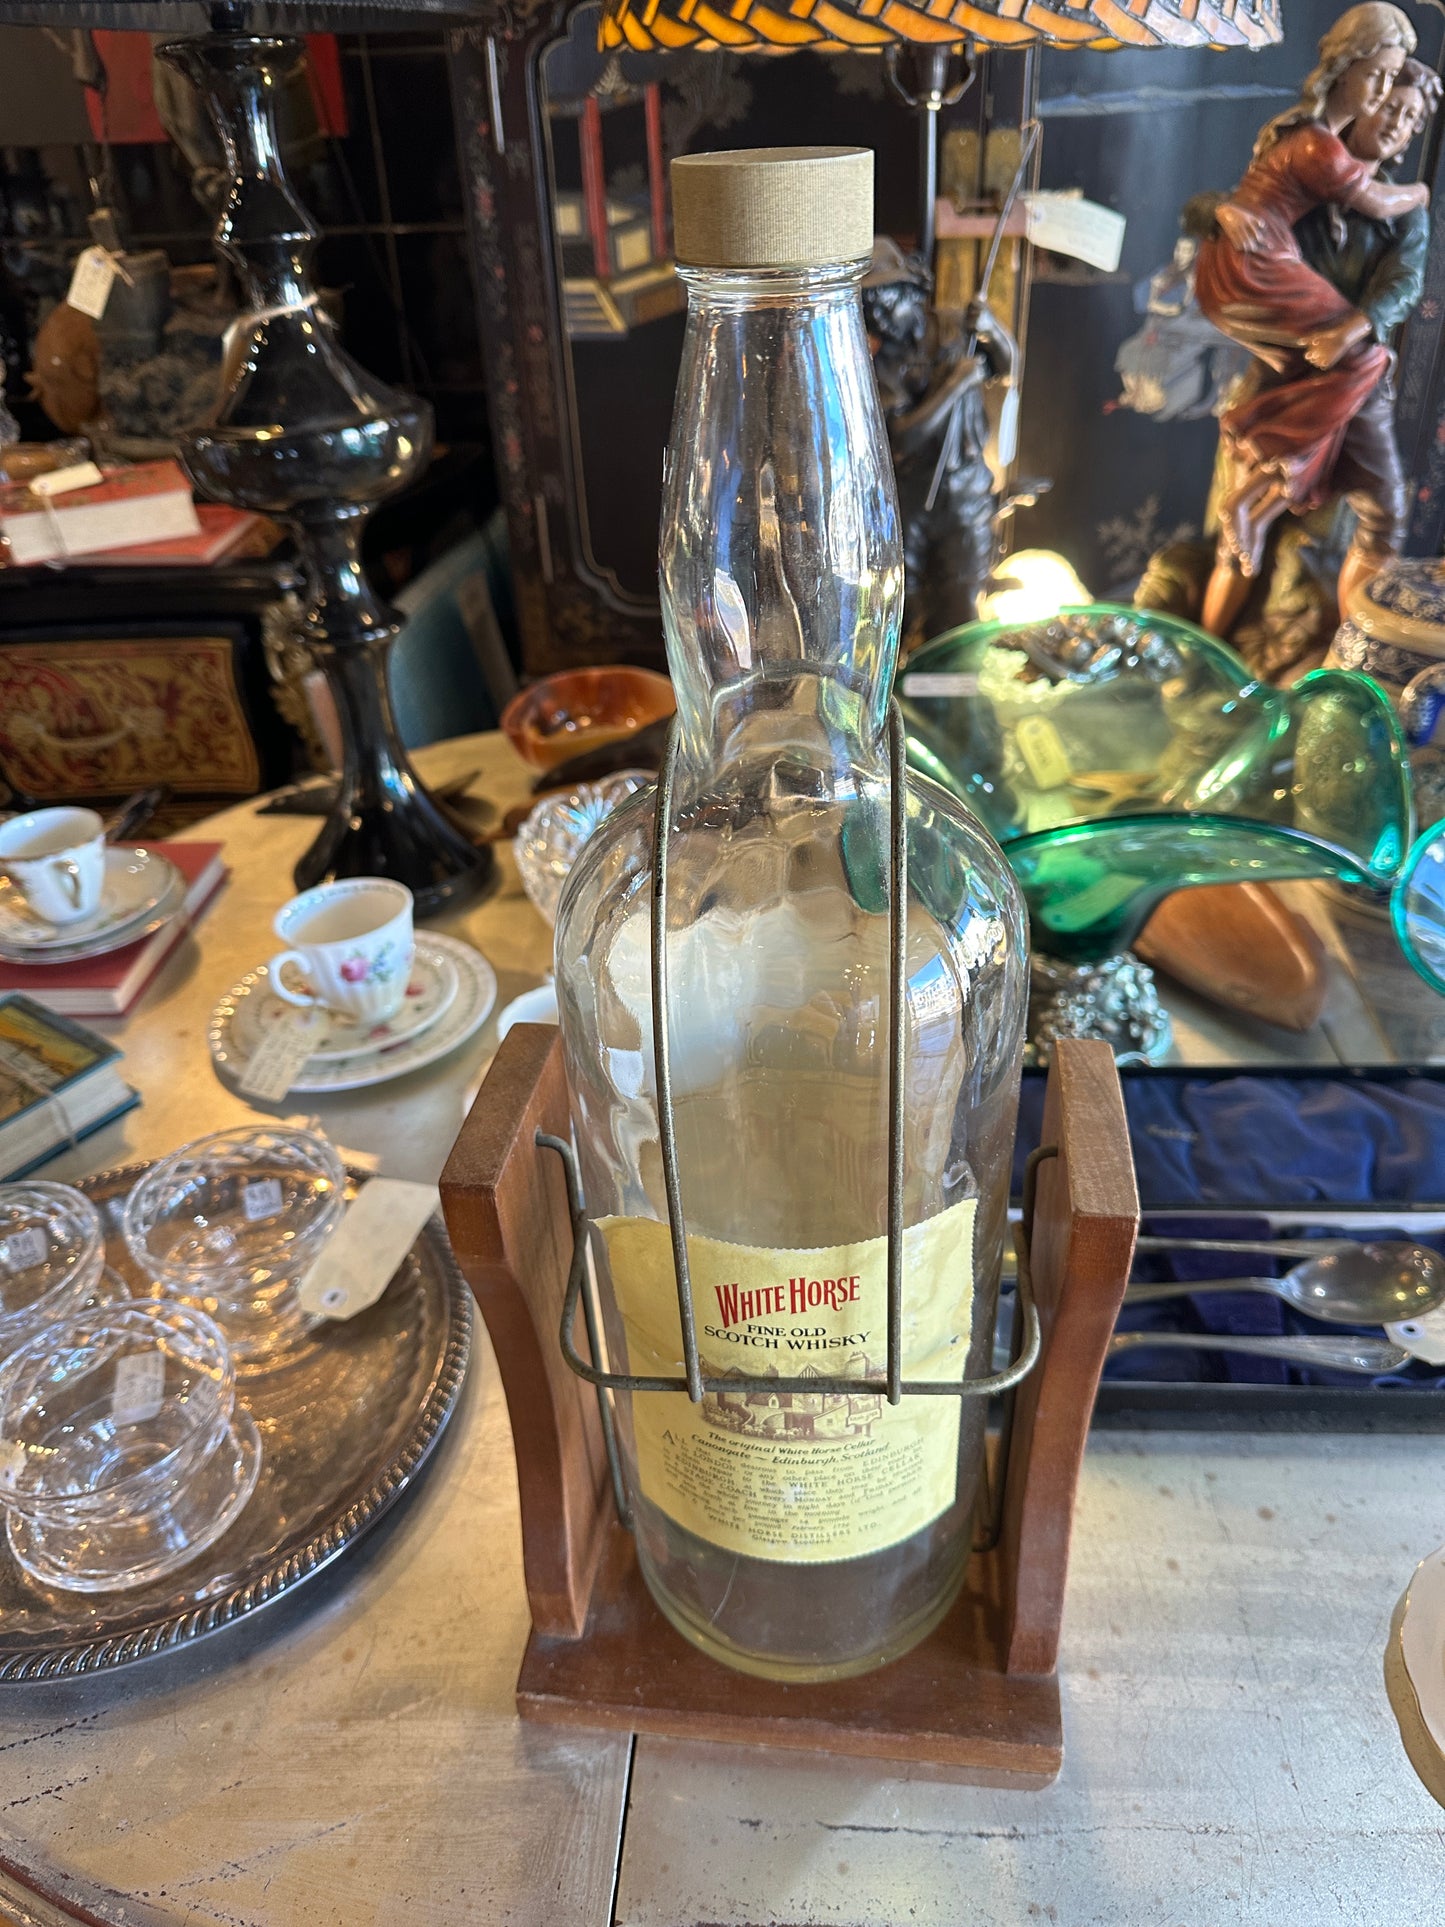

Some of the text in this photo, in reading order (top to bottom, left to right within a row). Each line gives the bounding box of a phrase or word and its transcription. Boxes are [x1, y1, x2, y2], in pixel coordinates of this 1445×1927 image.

[714, 1275, 861, 1329] WHITE HORSE
[704, 1325, 872, 1350] SCOTCH WHISKY
[747, 1323, 826, 1337] FINE OLD
[691, 1434, 751, 1459] Canongate
[841, 1441, 890, 1462] Scotland
[708, 1432, 876, 1455] The original White Horse Cellar
